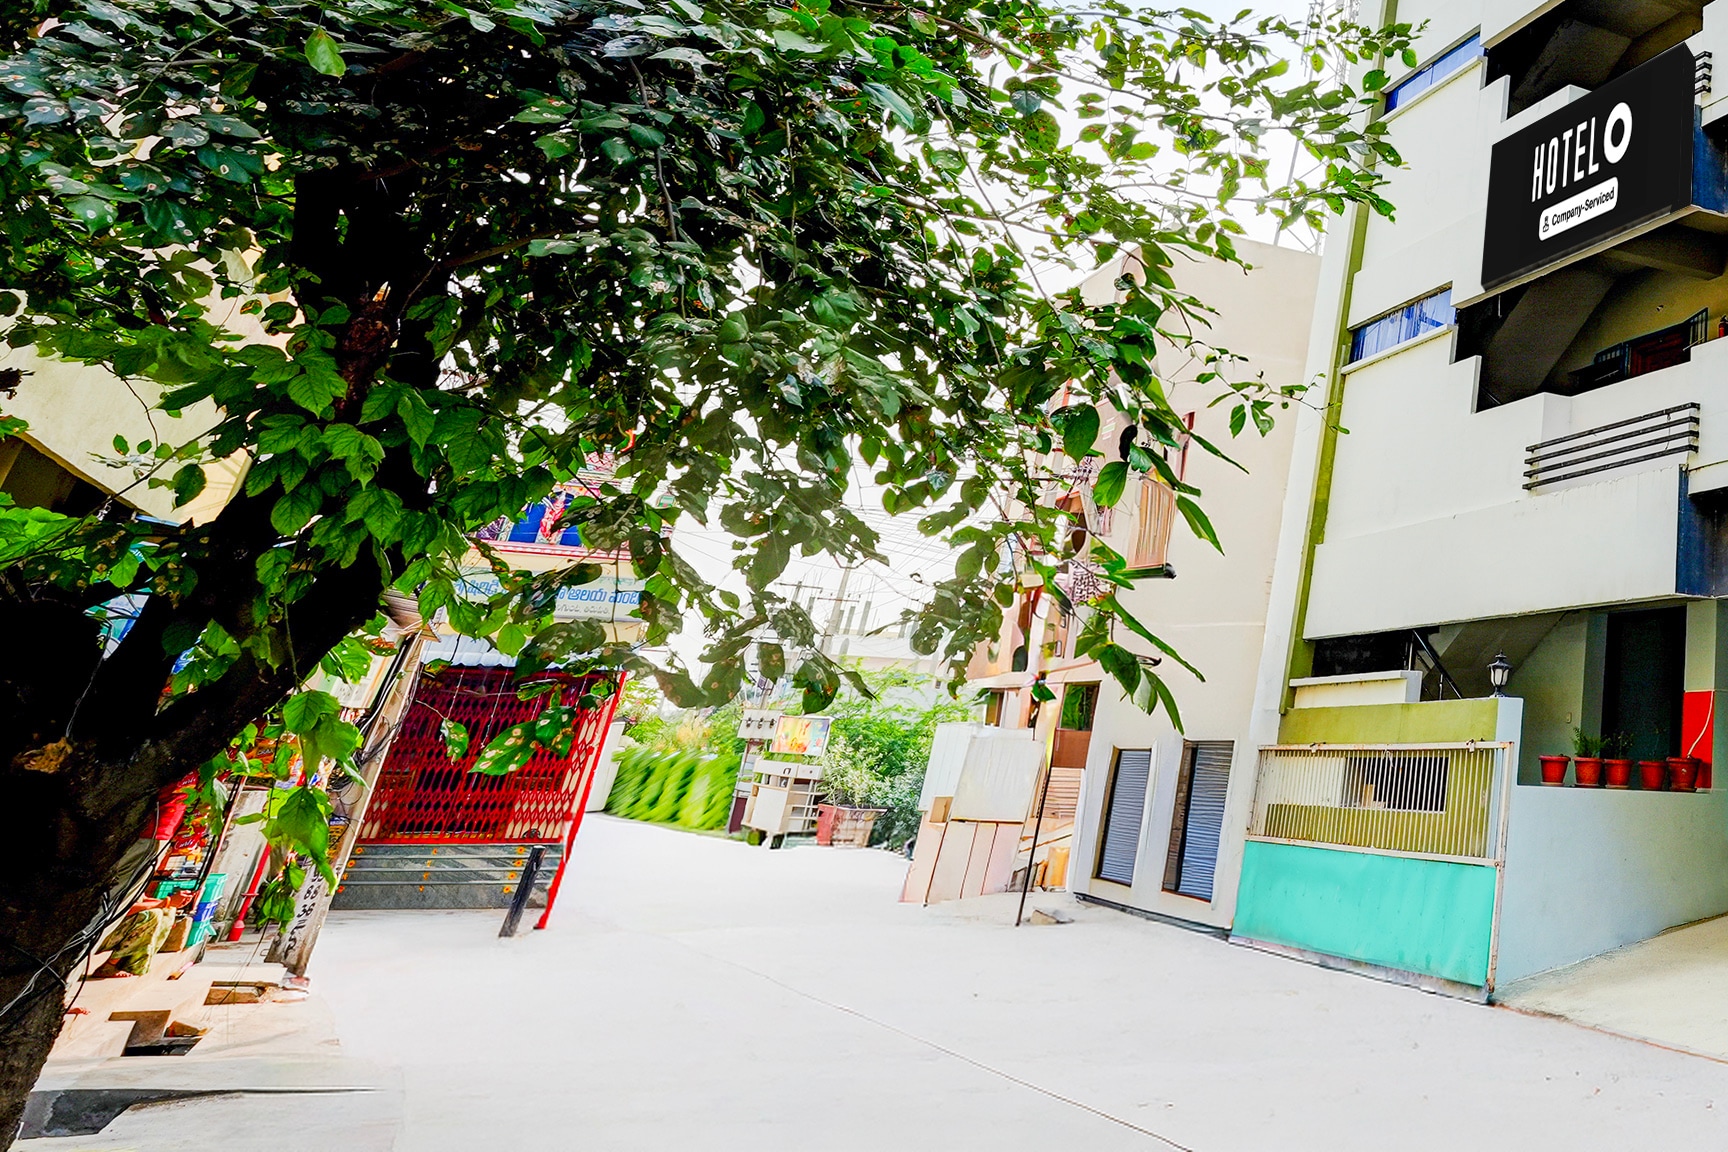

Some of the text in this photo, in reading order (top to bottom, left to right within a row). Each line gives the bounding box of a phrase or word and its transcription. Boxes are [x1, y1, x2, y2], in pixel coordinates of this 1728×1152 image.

[1531, 102, 1633, 203] HOTEL O
[1551, 186, 1615, 226] Company-Serviced
